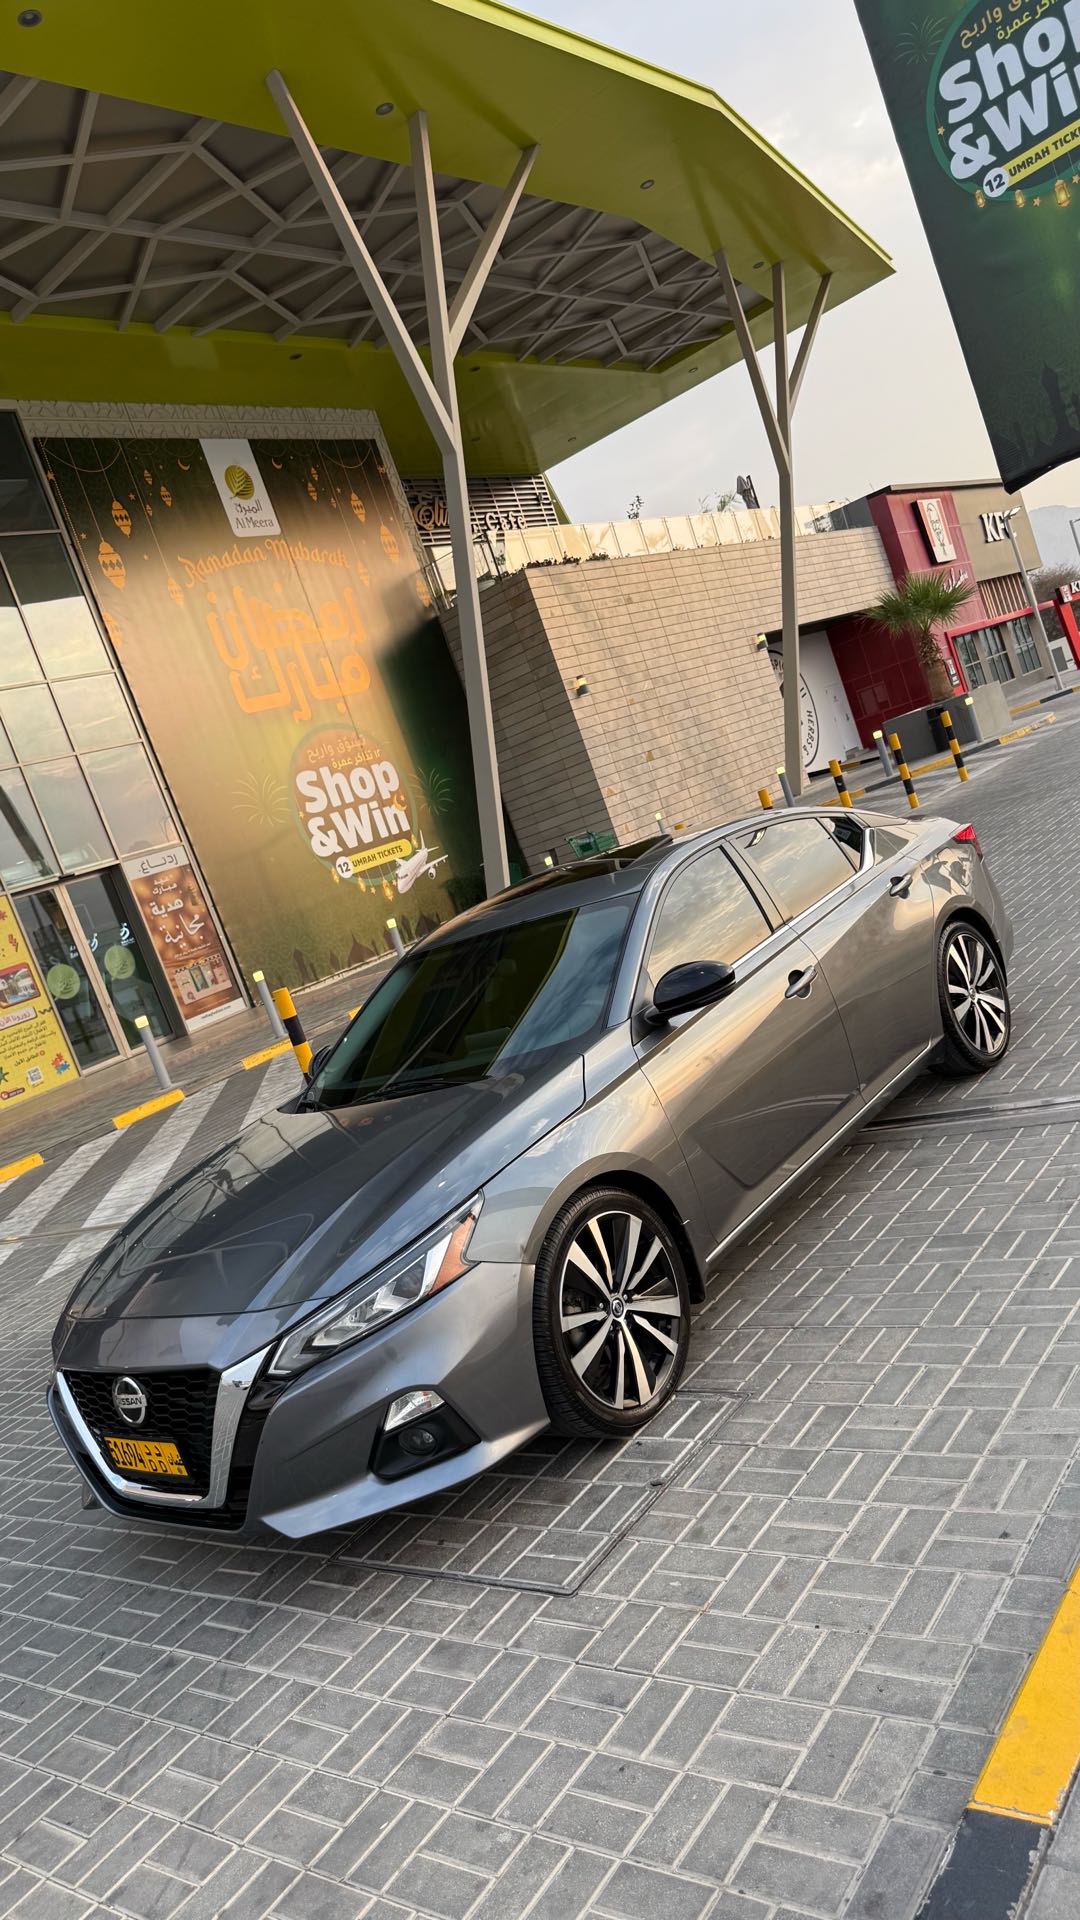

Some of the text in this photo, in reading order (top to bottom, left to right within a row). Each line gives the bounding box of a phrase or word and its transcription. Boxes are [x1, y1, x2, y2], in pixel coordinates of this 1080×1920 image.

[996, 11, 1032, 40] عمرة
[949, 61, 1080, 180] &Wi
[985, 173, 1006, 193] 12
[1008, 146, 1051, 178] UMRAH
[246, 517, 275, 529] Meera
[485, 511, 527, 532] Cafe
[177, 538, 350, 590] Ramadan Mubarak
[1070, 579, 1080, 594] K
[806, 709, 815, 748] HERBS
[332, 757, 353, 770] عمرة
[296, 760, 400, 813] Shop
[337, 845, 403, 874] 12 UMRAH TICKETS
[150, 898, 184, 918] هدية
[159, 914, 205, 949] مجانية
[108, 1440, 147, 1468] 51694
